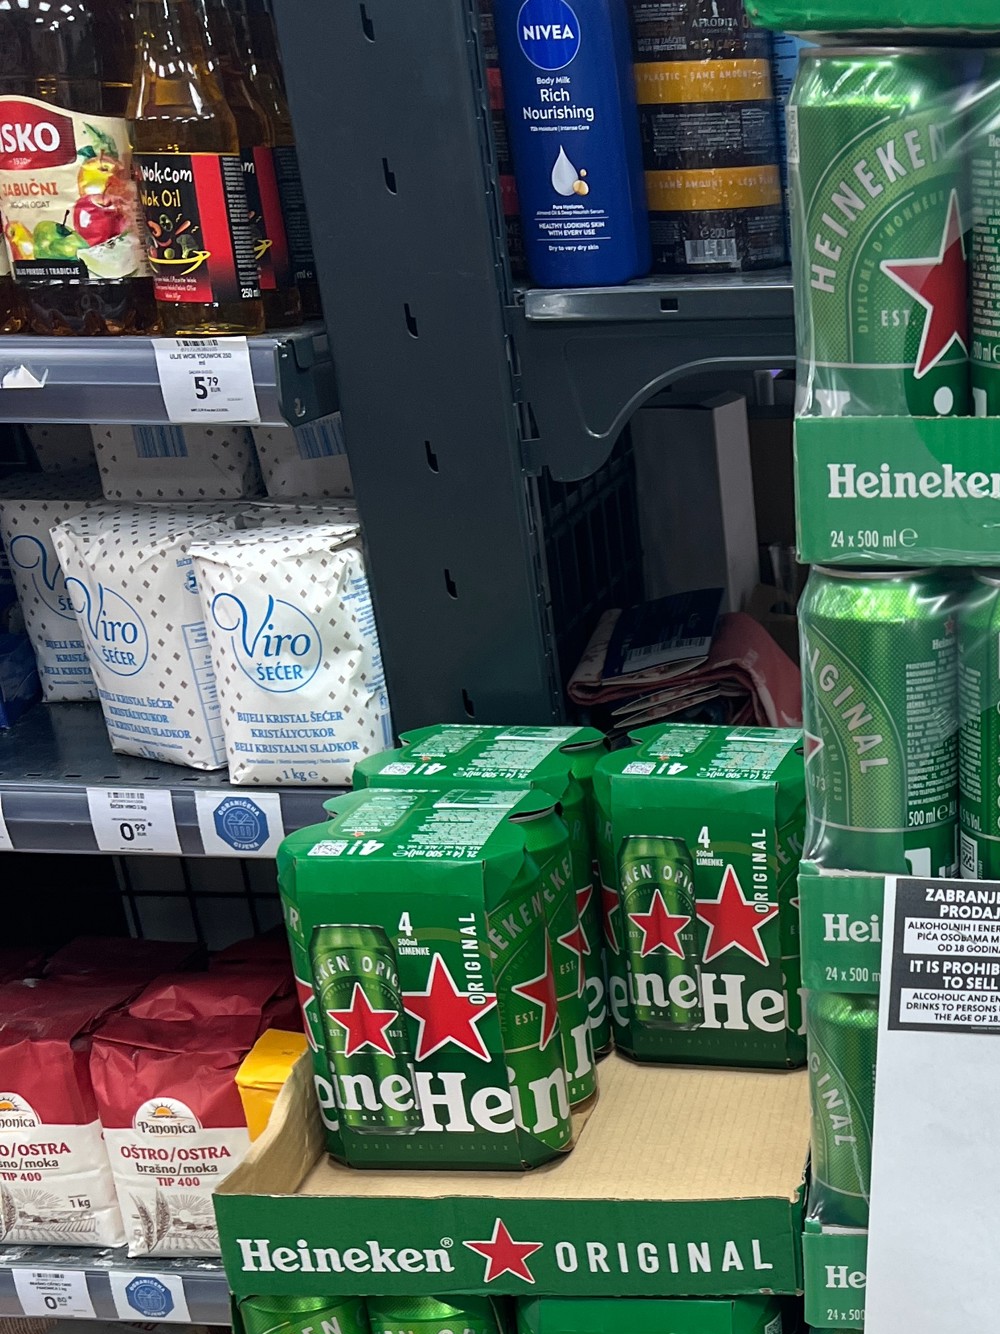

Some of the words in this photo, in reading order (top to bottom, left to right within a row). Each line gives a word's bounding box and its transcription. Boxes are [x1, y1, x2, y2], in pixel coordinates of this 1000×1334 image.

[523, 24, 575, 41] NIVEA
[536, 77, 555, 85] Body
[555, 76, 571, 84] Milk
[540, 88, 571, 102] Rich
[523, 105, 595, 121] Nourishing
[0, 122, 61, 153] SKO
[2, 178, 59, 197] JABUČNI
[161, 189, 181, 208] Oil
[539, 222, 563, 230] HEALTHY
[881, 309, 916, 327] EST.
[194, 376, 208, 400] 5
[207, 377, 219, 387] 79
[830, 530, 844, 547] 24
[847, 534, 855, 547] x
[857, 530, 879, 547] 500
[883, 530, 897, 547] ml
[66, 577, 138, 645] Viro
[211, 592, 311, 658] Viro
[257, 662, 304, 682] ŠEĆER
[237, 711, 266, 724] BIJELI
[266, 711, 307, 724] KRISTAL
[310, 709, 345, 723] ŠEĆER
[250, 726, 336, 739] KRISTÁLYCUKOR
[234, 741, 256, 753] BELI
[257, 741, 308, 753] KRISTALNI
[310, 740, 360, 753] SLADKOR
[282, 770, 290, 780] 1
[292, 768, 307, 782] kg
[909, 809, 925, 826] 500
[925, 808, 936, 825] ml
[119, 822, 135, 841] 0
[134, 824, 146, 832] 99
[398, 912, 413, 937] 4
[908, 921, 971, 932] ALKOHOLNIH
[397, 937, 418, 946] 500ml
[917, 931, 939, 941] PIĆA
[940, 934, 989, 943] OSOBAMA
[398, 947, 430, 956] LIMENKE
[937, 944, 952, 952] OD
[463, 912, 488, 1006] ORIGINAL
[909, 960, 923, 973] IT
[926, 960, 940, 974] IS
[943, 976, 963, 989] TO
[966, 977, 999, 990] SELL
[912, 992, 966, 1002] ALCOHOLIC
[967, 994, 988, 1003] AND
[906, 1002, 940, 1011] DRINKS
[941, 1003, 954, 1011] TO
[956, 1004, 997, 1013] PERSONS
[514, 1012, 539, 1026] EST.
[934, 1013, 952, 1021] THE
[953, 1014, 972, 1022] AGE
[974, 1014, 987, 1022] OF
[137, 1120, 197, 1136] Panonica
[120, 1145, 231, 1161] OŠTRO/OSTRA
[136, 1161, 218, 1175] brašno/moka
[156, 1176, 174, 1187] TIP
[177, 1176, 201, 1187] 400
[236, 1238, 454, 1274] Heineken
[555, 1238, 773, 1274] ORIGINAL
[44, 1295, 58, 1310] 0
